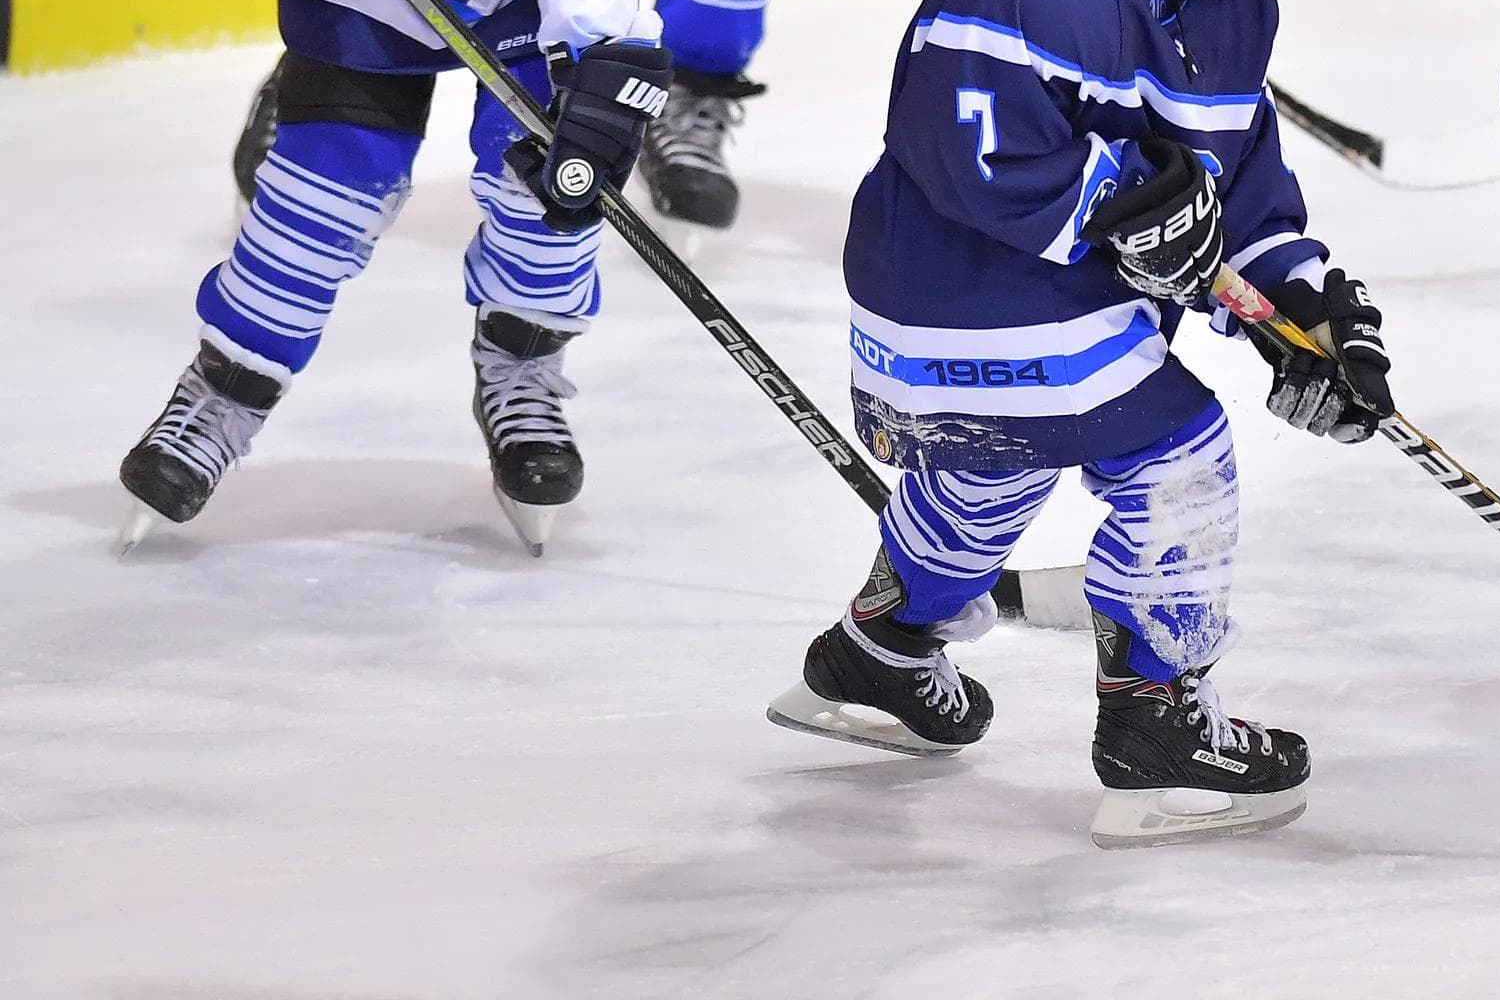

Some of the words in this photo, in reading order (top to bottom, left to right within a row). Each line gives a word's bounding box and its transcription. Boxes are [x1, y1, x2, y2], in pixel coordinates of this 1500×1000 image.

[955, 87, 998, 182] 7
[705, 318, 853, 469] FISCHER
[923, 359, 1050, 386] 1964
